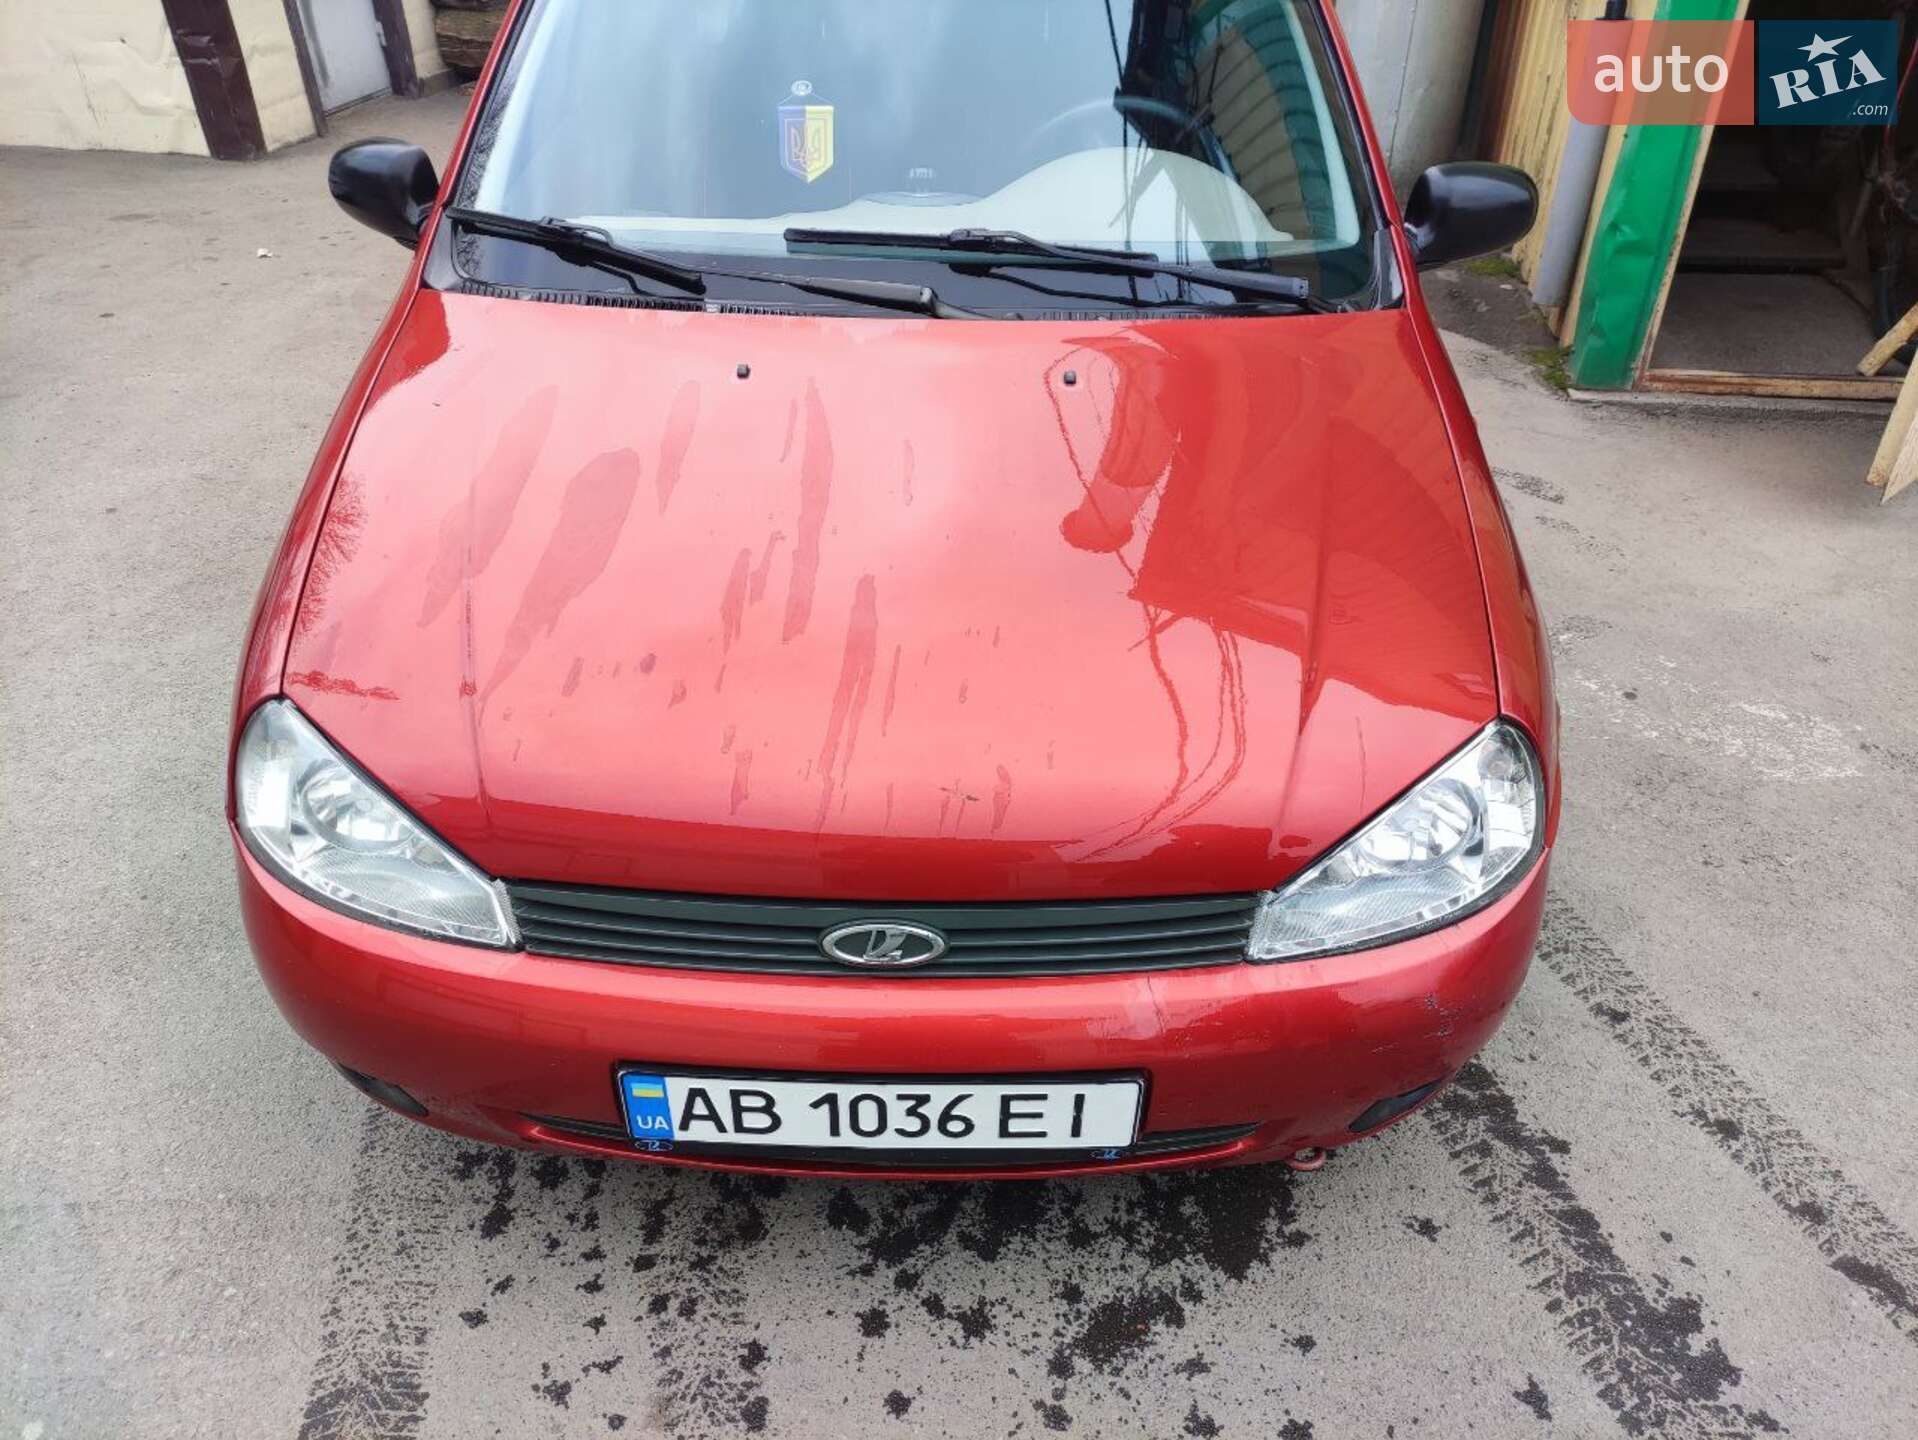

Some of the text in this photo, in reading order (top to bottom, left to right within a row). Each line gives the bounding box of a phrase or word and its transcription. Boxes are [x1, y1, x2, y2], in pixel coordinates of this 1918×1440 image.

[636, 1115, 670, 1130] UA
[678, 1087, 1086, 1138] AB 1036 EI
